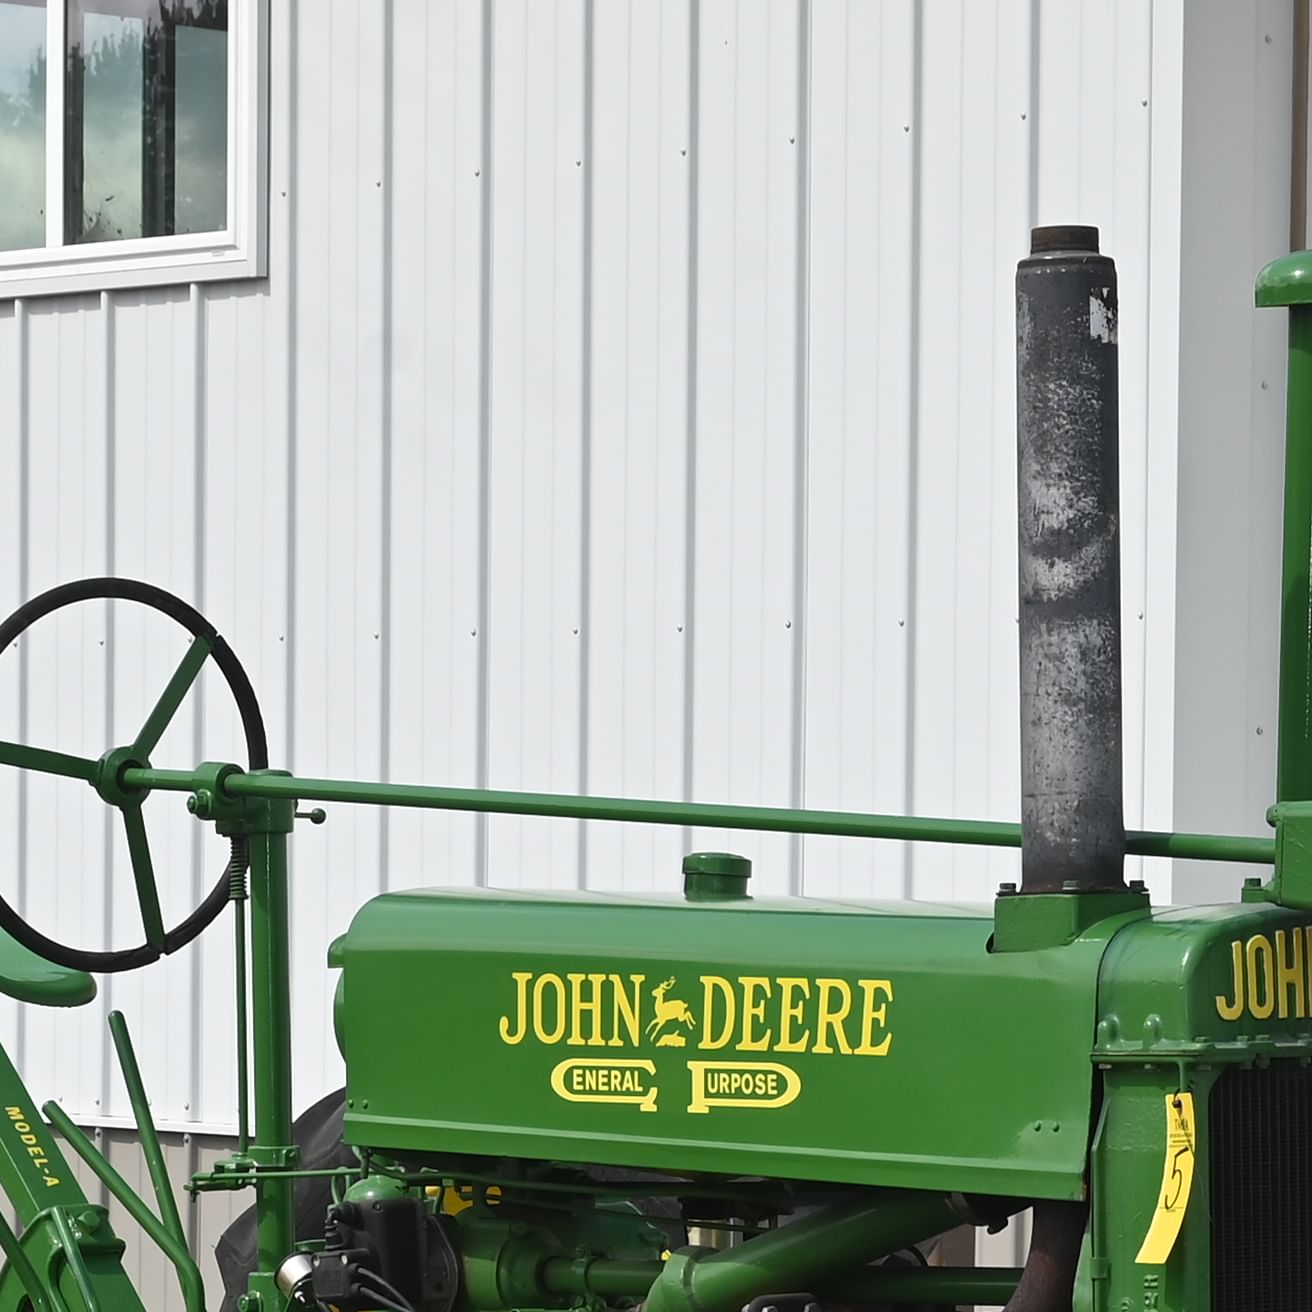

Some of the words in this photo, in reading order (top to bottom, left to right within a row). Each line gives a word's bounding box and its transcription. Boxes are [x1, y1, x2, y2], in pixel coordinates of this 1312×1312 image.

[498, 971, 646, 1047] JOHN
[697, 975, 894, 1057] DEERE
[4, 1105, 61, 1188] MODEL-A
